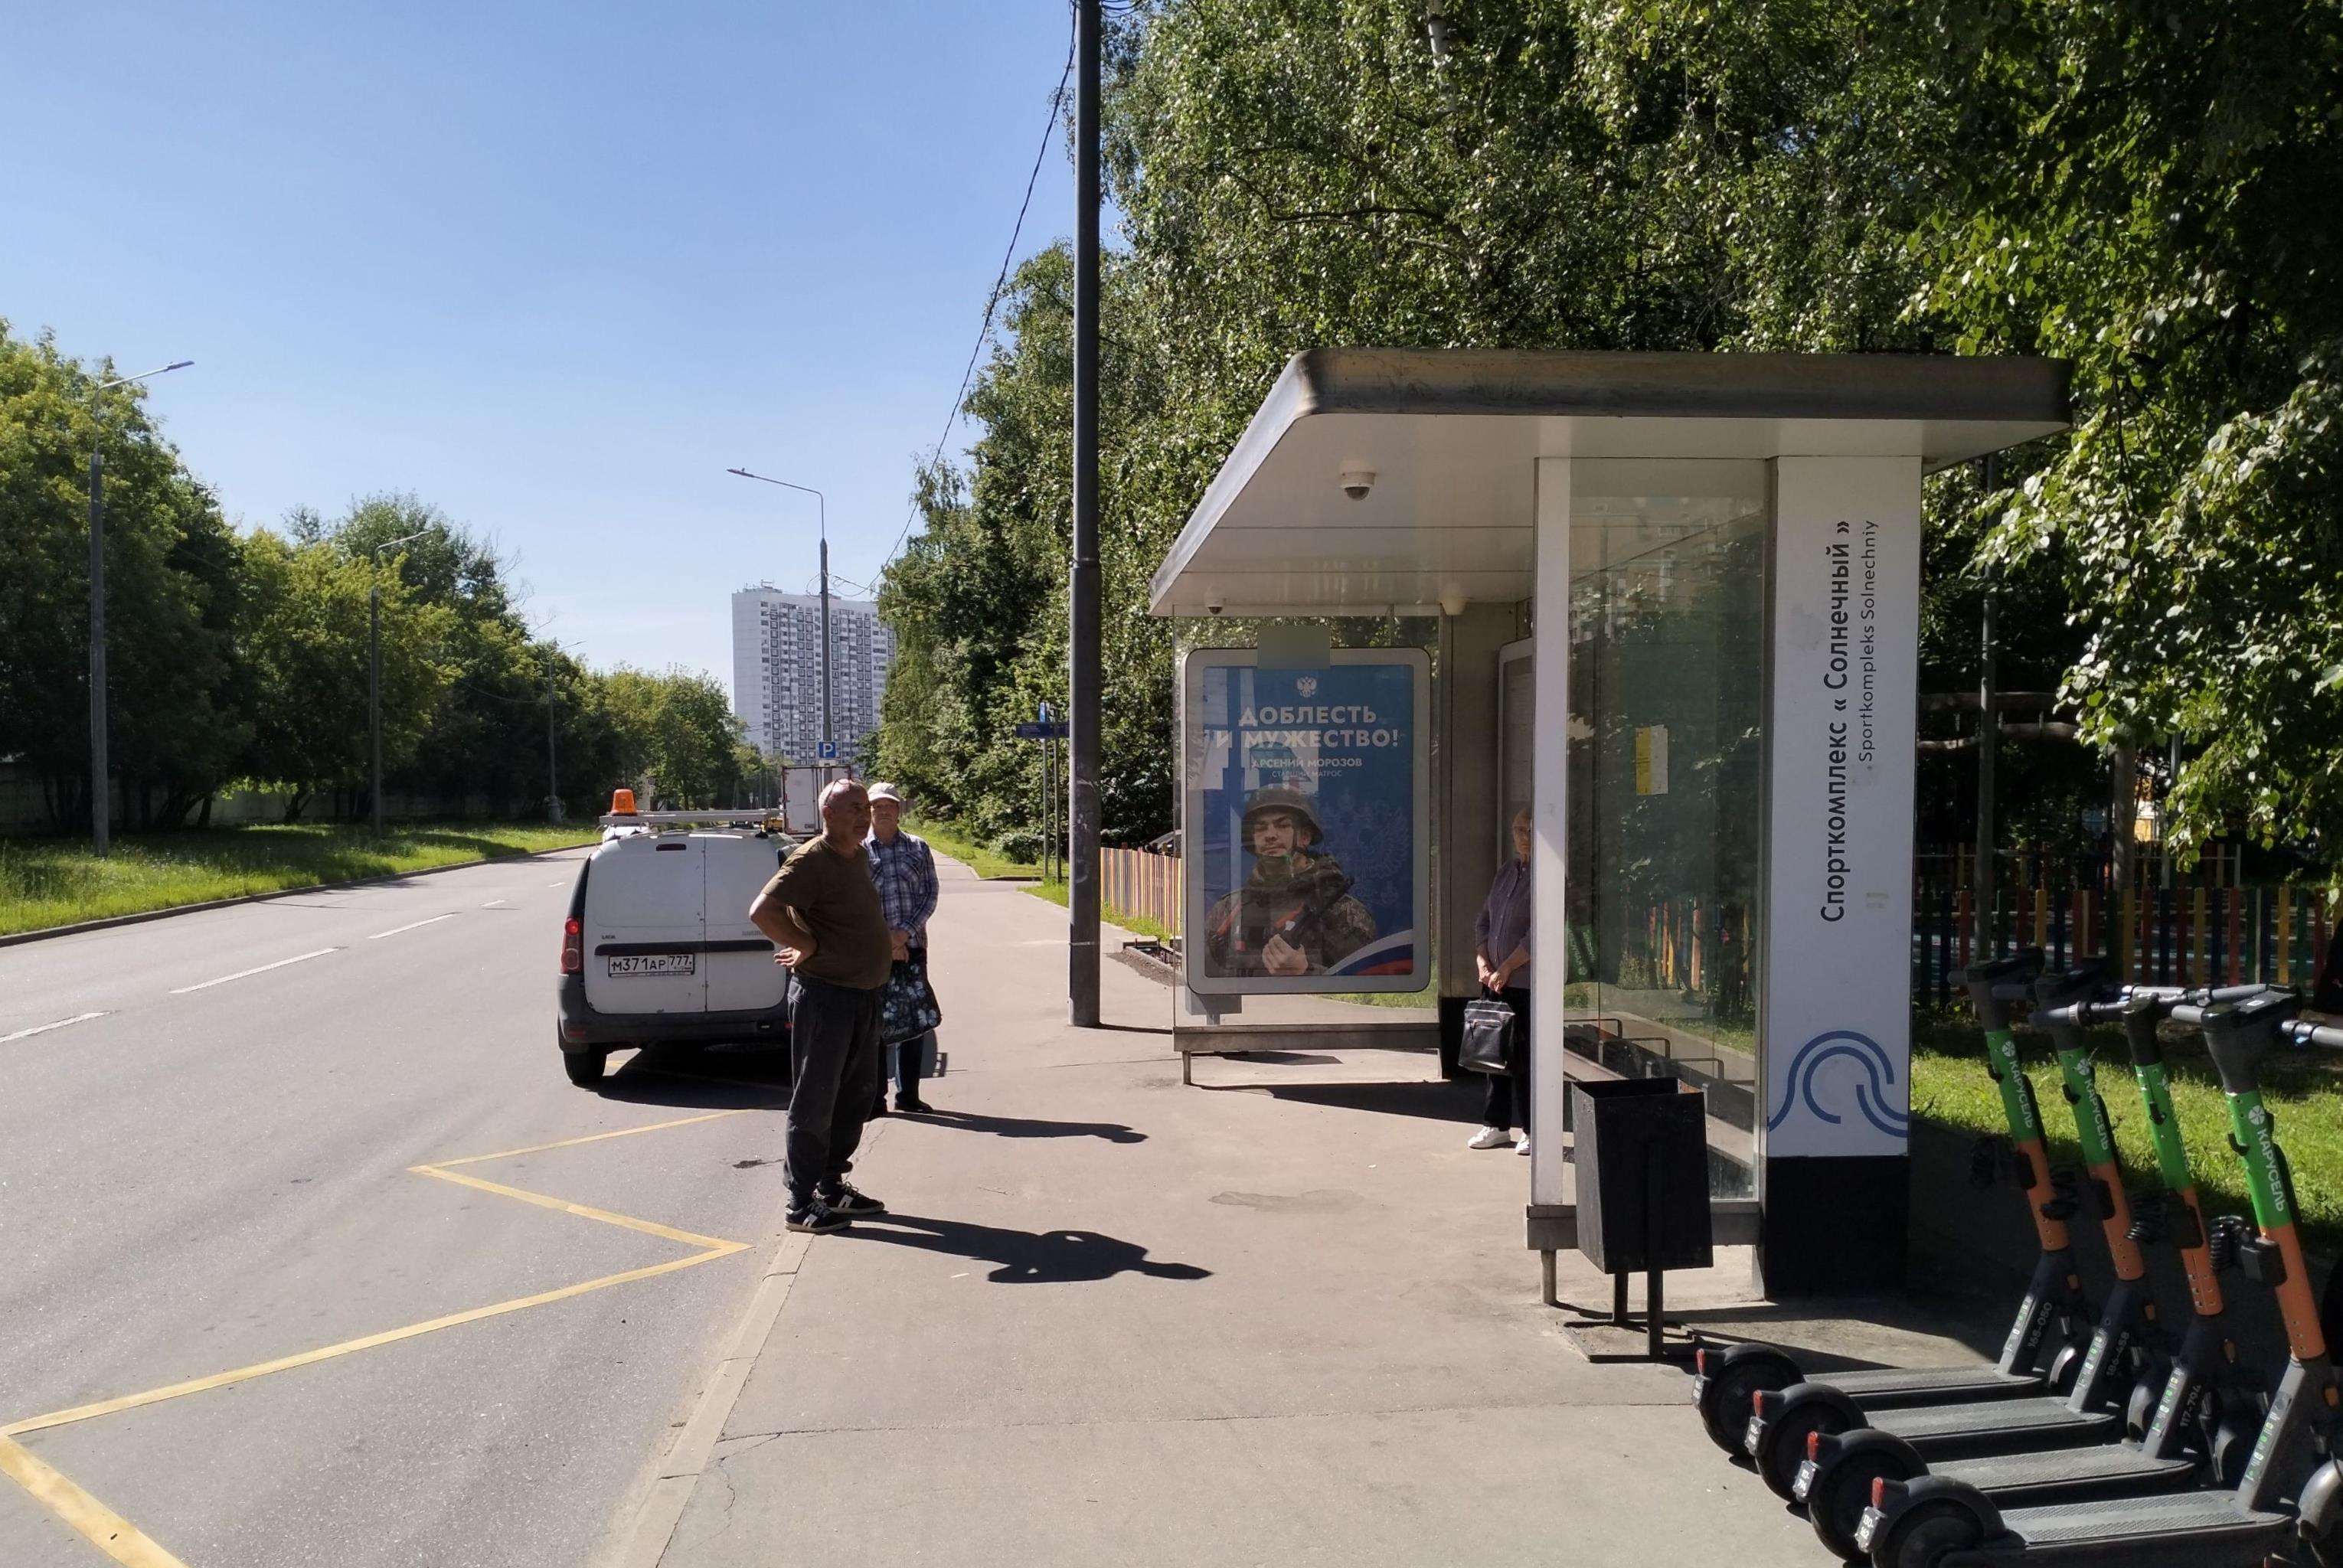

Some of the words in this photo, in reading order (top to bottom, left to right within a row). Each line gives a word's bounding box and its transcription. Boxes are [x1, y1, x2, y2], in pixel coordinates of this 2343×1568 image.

[1860, 520, 1879, 619] Solnechniy
[1823, 544, 1849, 690] Солнечный
[1237, 705, 1377, 727] ДОБЛЕСТЬ
[1858, 625, 1877, 762] Sportkompleks
[1216, 730, 1234, 748] И
[1243, 729, 1399, 748] МУЖЕСТВО!
[1251, 756, 1304, 769] АРСЕНИЙ
[1307, 757, 1363, 768] МОРОЗОВ
[1820, 722, 1851, 923] Спорткомплекс
[668, 956, 690, 965] 777
[2008, 1060, 2033, 1129] КАРУСЕЛЬ
[2084, 1078, 2109, 1150] КАРУСЕЛЬ
[2257, 1129, 2285, 1212] КАРУСЕЛЬ
[2180, 1384, 2202, 1427] 117-794
